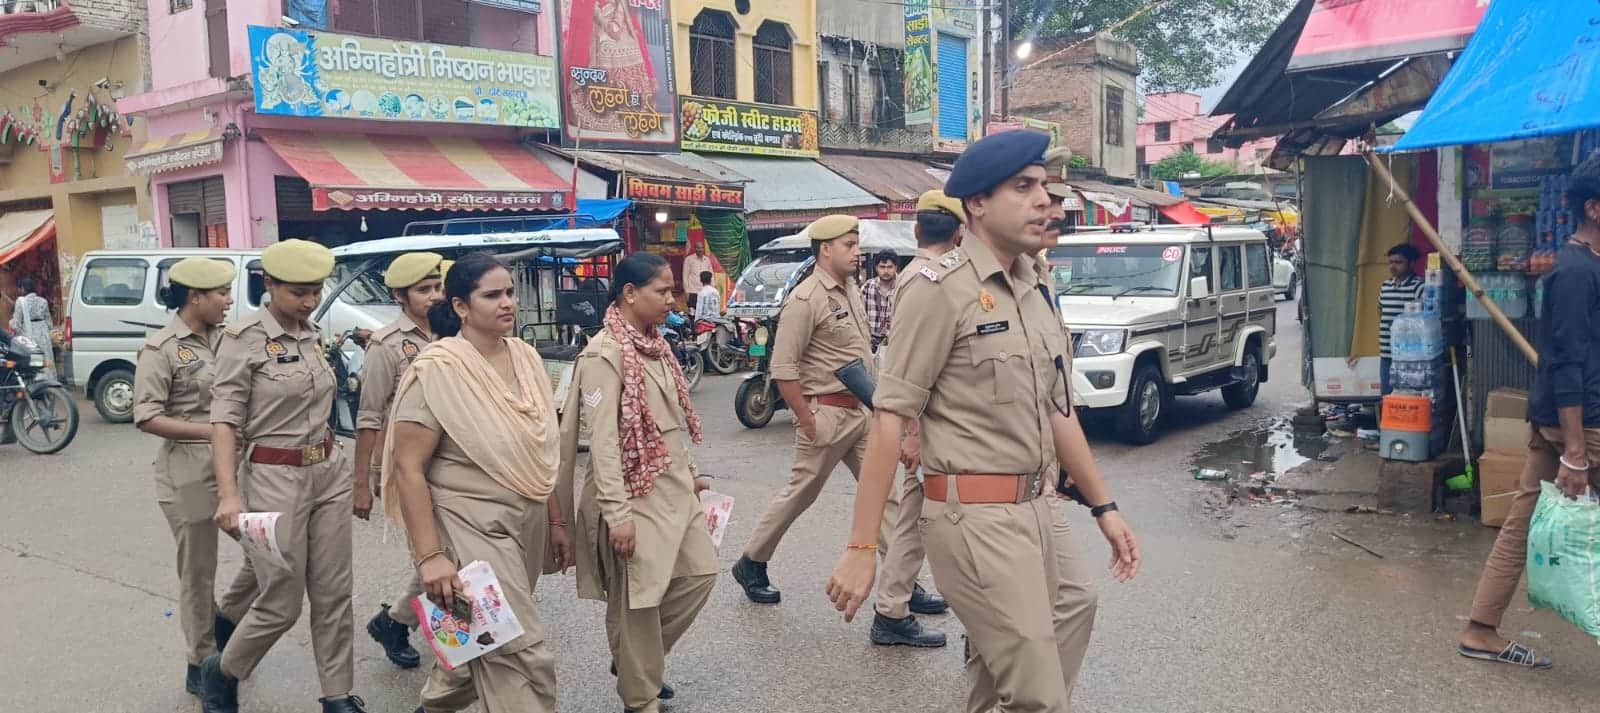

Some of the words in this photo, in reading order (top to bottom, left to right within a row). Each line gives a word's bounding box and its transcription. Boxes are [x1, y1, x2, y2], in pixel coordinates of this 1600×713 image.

[320, 38, 425, 77] अग्निहोत्री
[428, 45, 494, 82] मिष्ठान
[498, 62, 553, 88] भण्डार
[703, 104, 738, 127] फौजी
[741, 108, 769, 130] स्वीट
[771, 115, 802, 133] हाउस
[355, 191, 442, 204] अग्निहोत्री
[502, 196, 541, 205] हाउस
[628, 178, 672, 199] शिवम
[674, 183, 706, 205] साड़ी
[1096, 246, 1127, 254] POLICE
